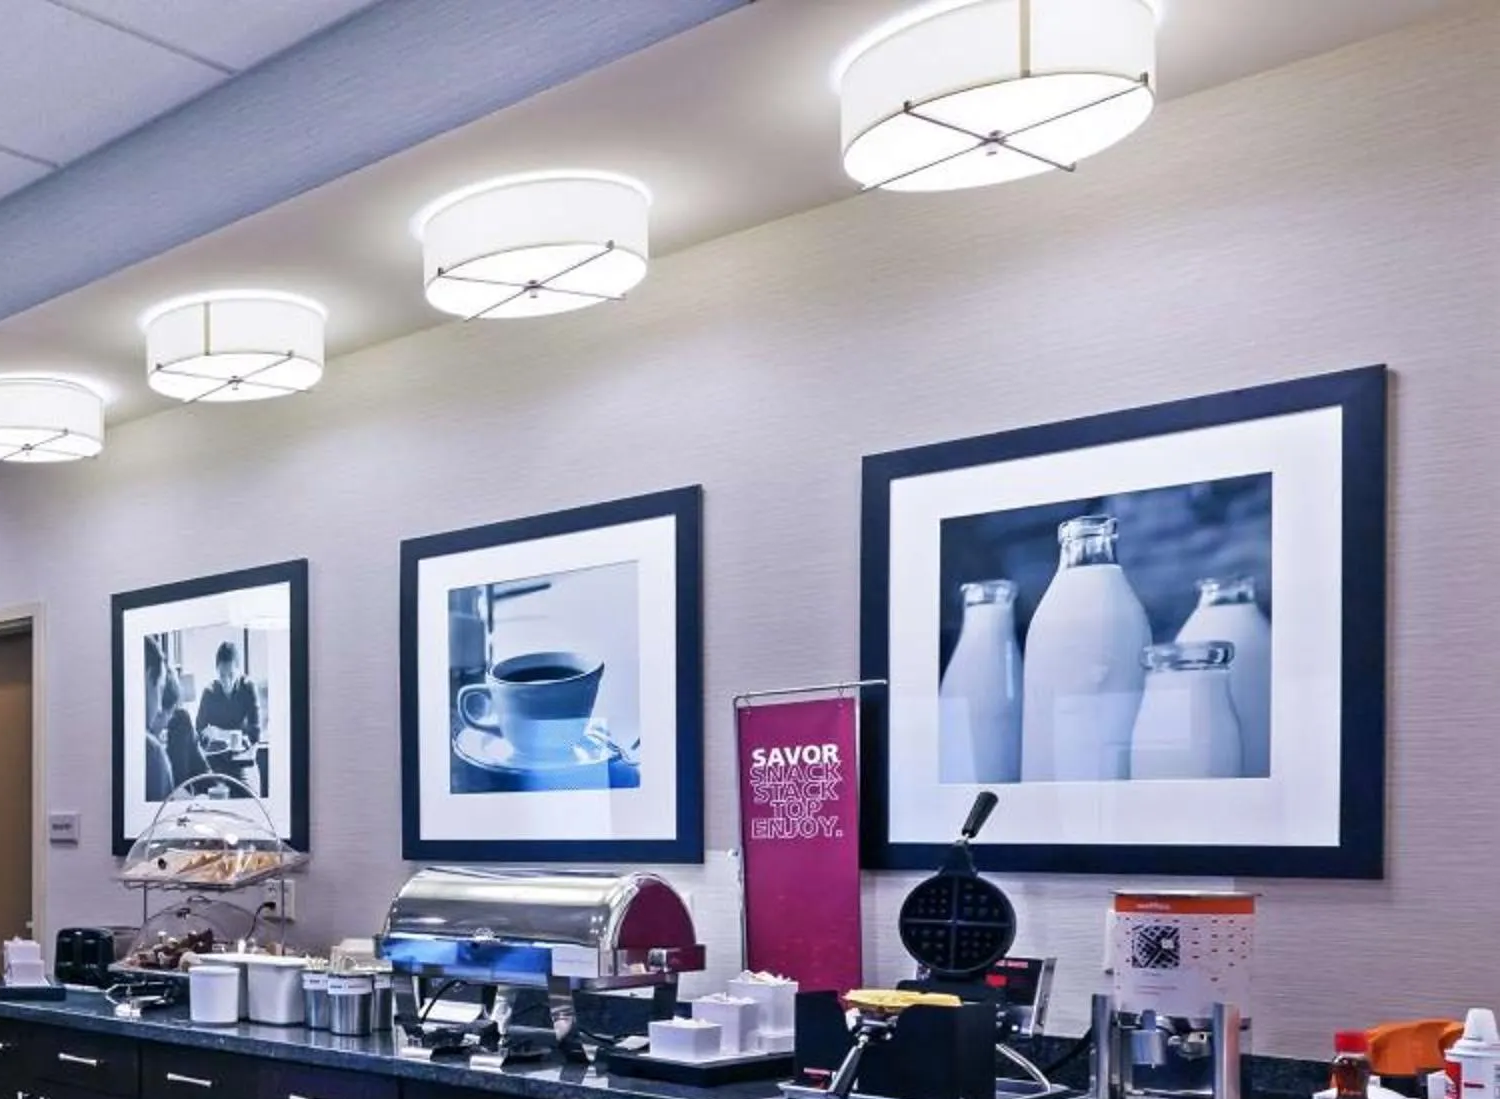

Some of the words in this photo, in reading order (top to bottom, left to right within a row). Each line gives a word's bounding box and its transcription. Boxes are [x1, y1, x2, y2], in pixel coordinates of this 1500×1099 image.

[751, 743, 840, 767] SAVOR
[749, 760, 843, 784] SNACK
[753, 779, 840, 804] STACK
[770, 798, 823, 820] TOP
[750, 815, 845, 840] ENJOY.
